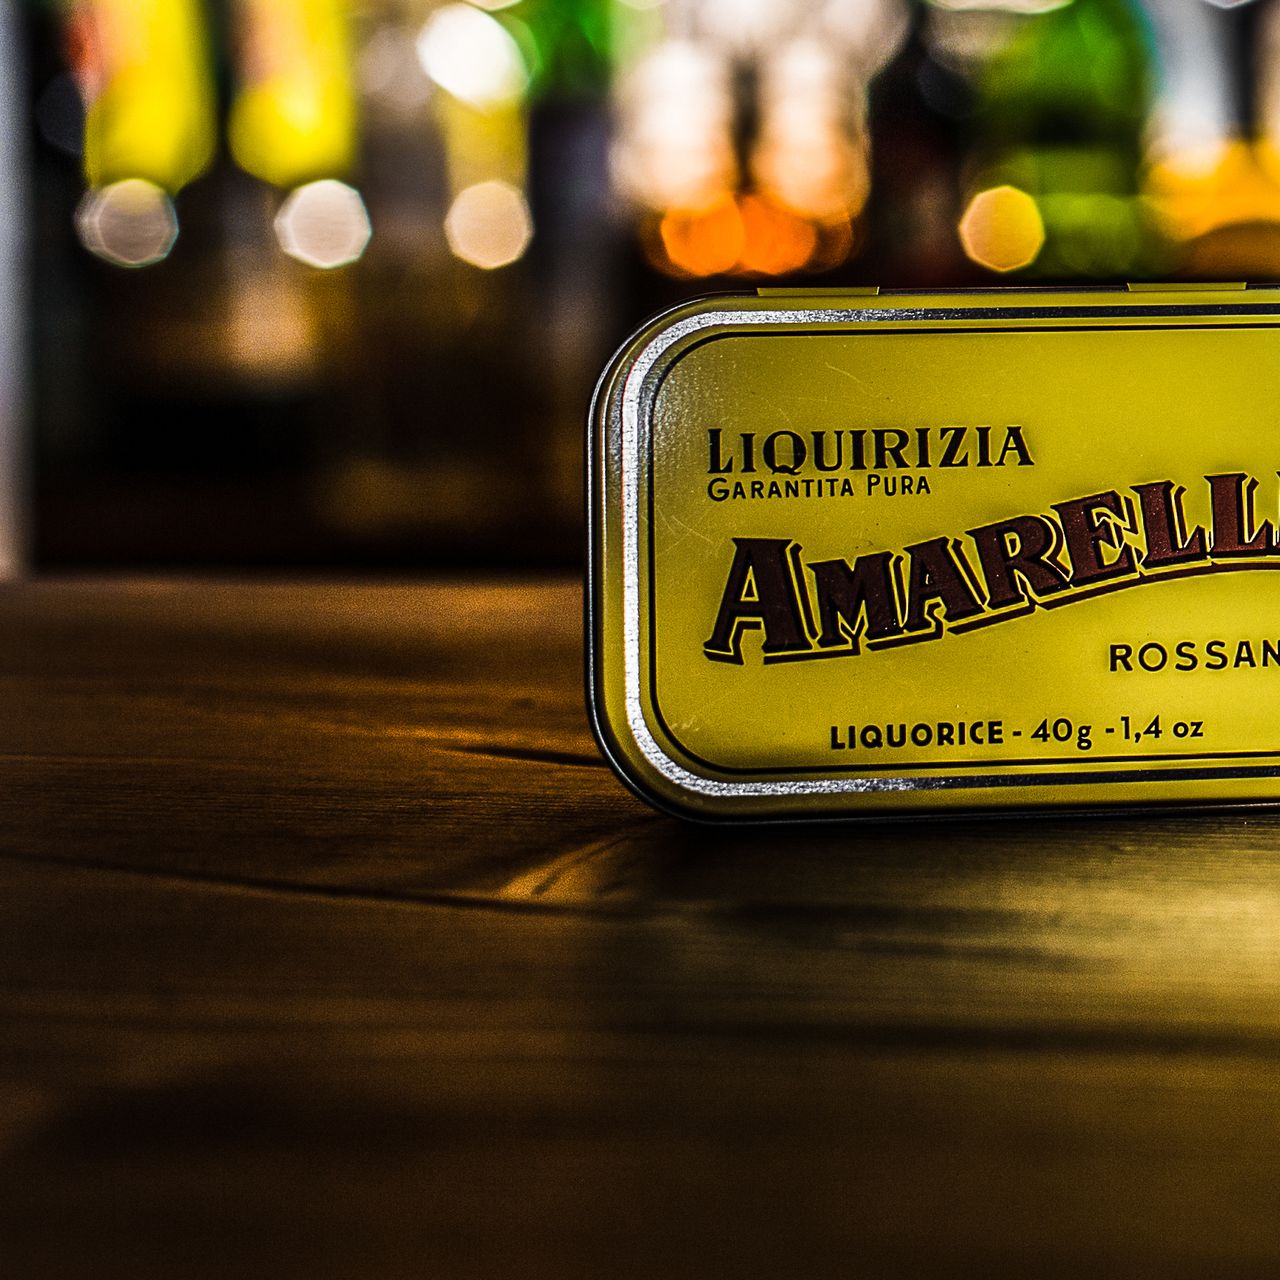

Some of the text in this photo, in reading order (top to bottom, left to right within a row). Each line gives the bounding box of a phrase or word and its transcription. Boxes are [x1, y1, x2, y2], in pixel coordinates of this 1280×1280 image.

[707, 425, 1035, 475] LIQUIRIZIA
[707, 474, 932, 502] GARANTITA PURA
[829, 720, 1004, 750] LIQUORICE
[1030, 718, 1093, 750] 40g
[1172, 720, 1204, 738] oz
